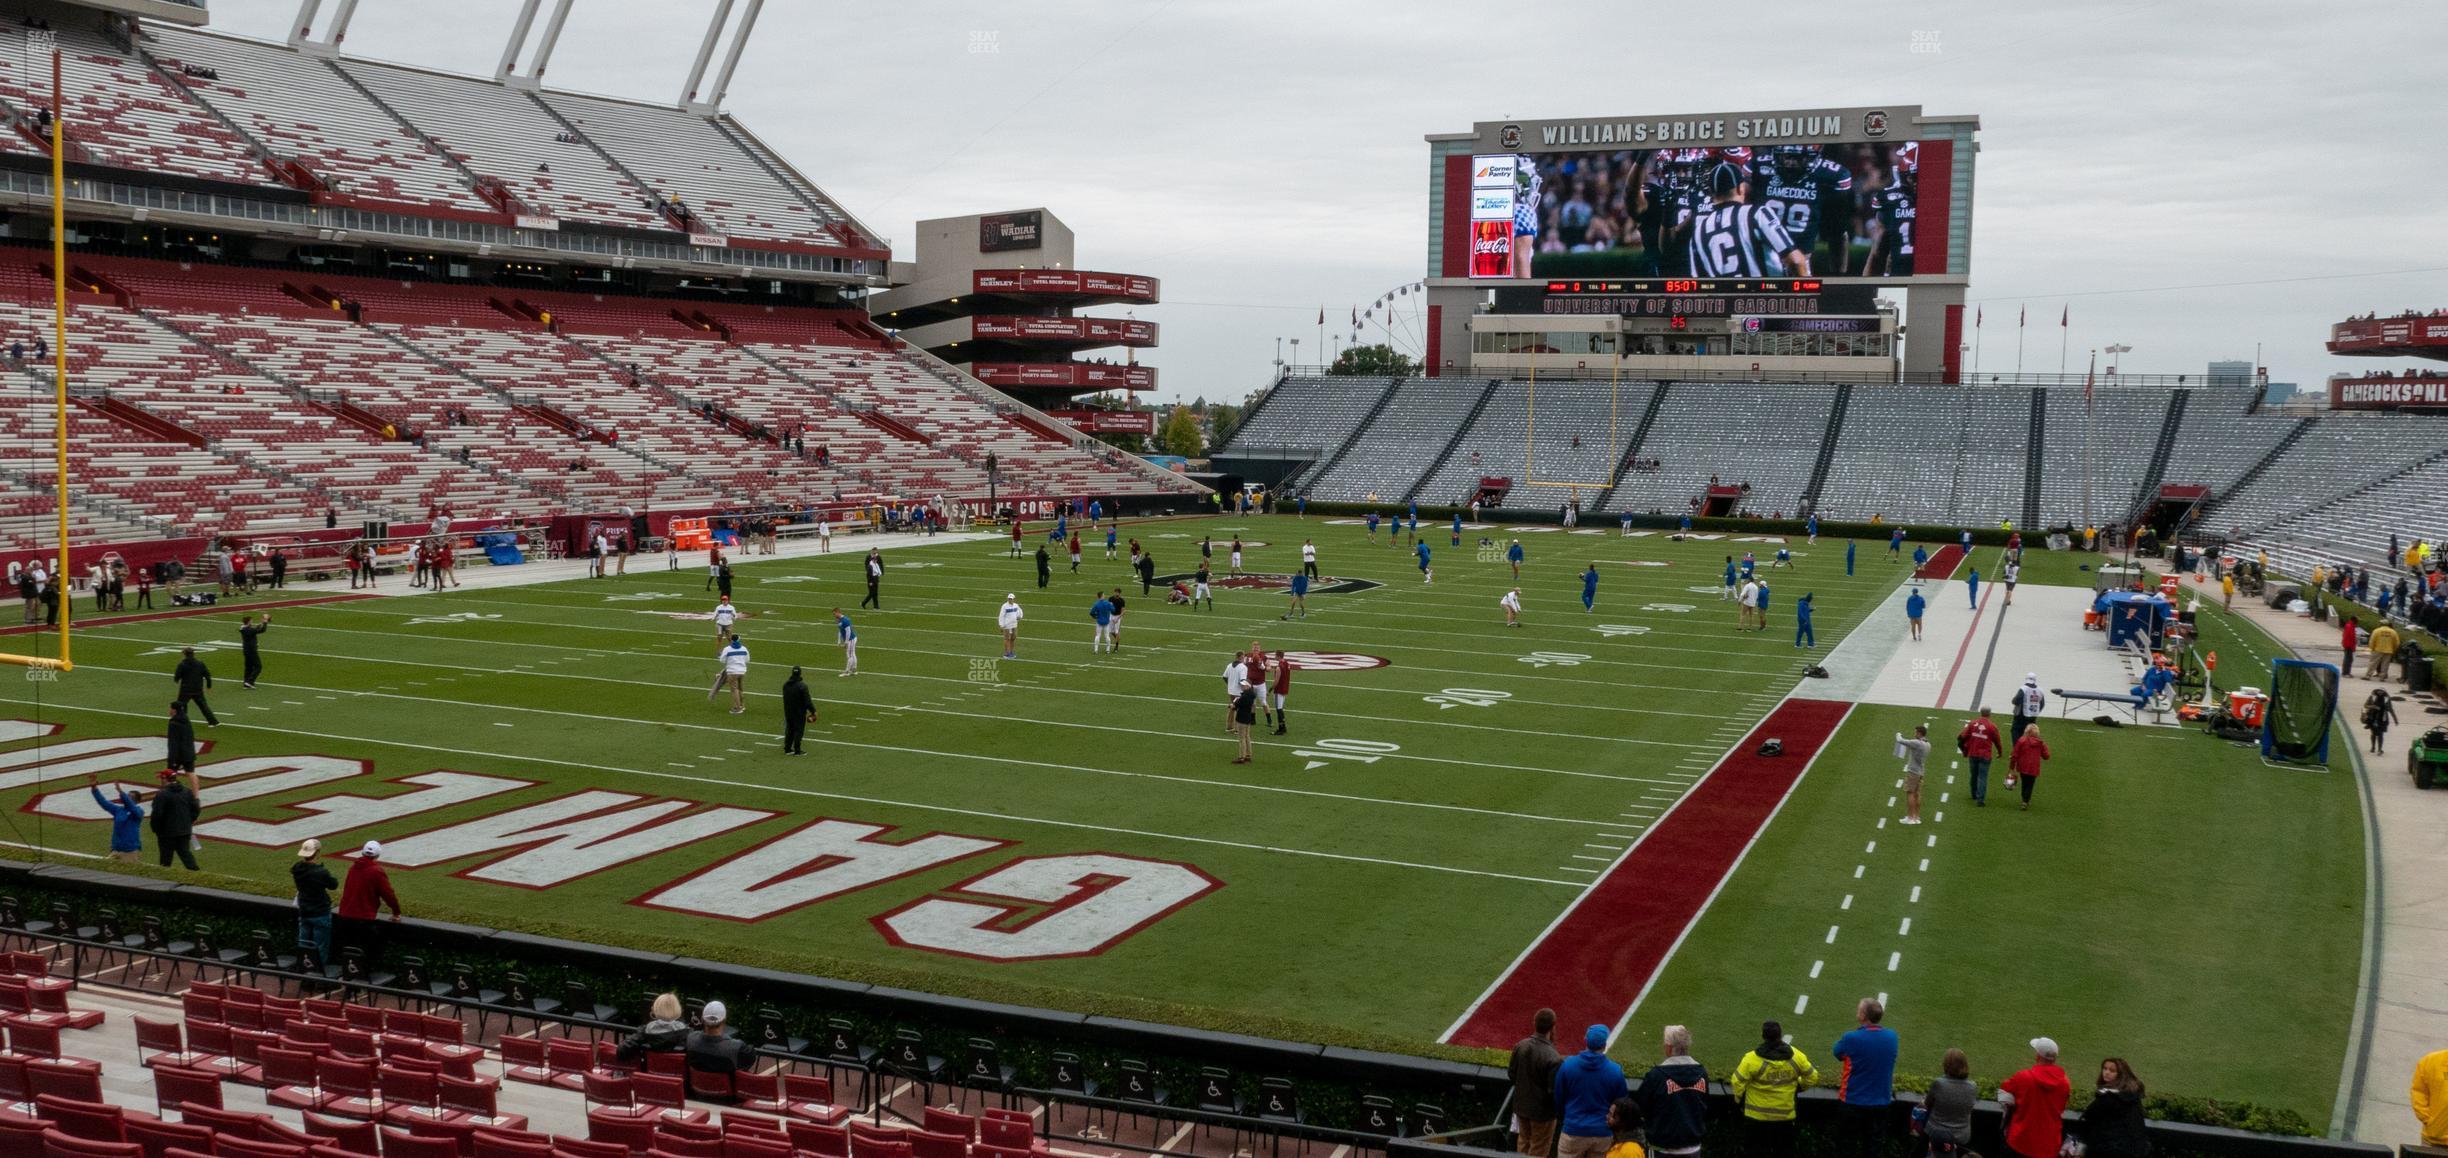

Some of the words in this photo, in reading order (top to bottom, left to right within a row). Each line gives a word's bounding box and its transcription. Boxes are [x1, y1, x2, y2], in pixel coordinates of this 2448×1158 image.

[1542, 120, 1725, 145] WILLIAMS-BRICE
[1737, 115, 1841, 139] STADIUM
[1766, 186, 1817, 200] GAMECOCKS
[1000, 225, 1036, 237] WADIAK
[694, 236, 723, 245] NISSAN
[1573, 281, 1580, 292] 0
[1666, 280, 1697, 292] 85:07
[1793, 281, 1800, 291] 0
[1543, 298, 1639, 313] UNIVERSITY
[1646, 298, 1666, 313] OF
[1672, 298, 1725, 314] SOUTH
[1734, 298, 1818, 313] CAROLINA
[1671, 316, 1686, 329] 25
[1791, 319, 1859, 332] GAMECOCKS
